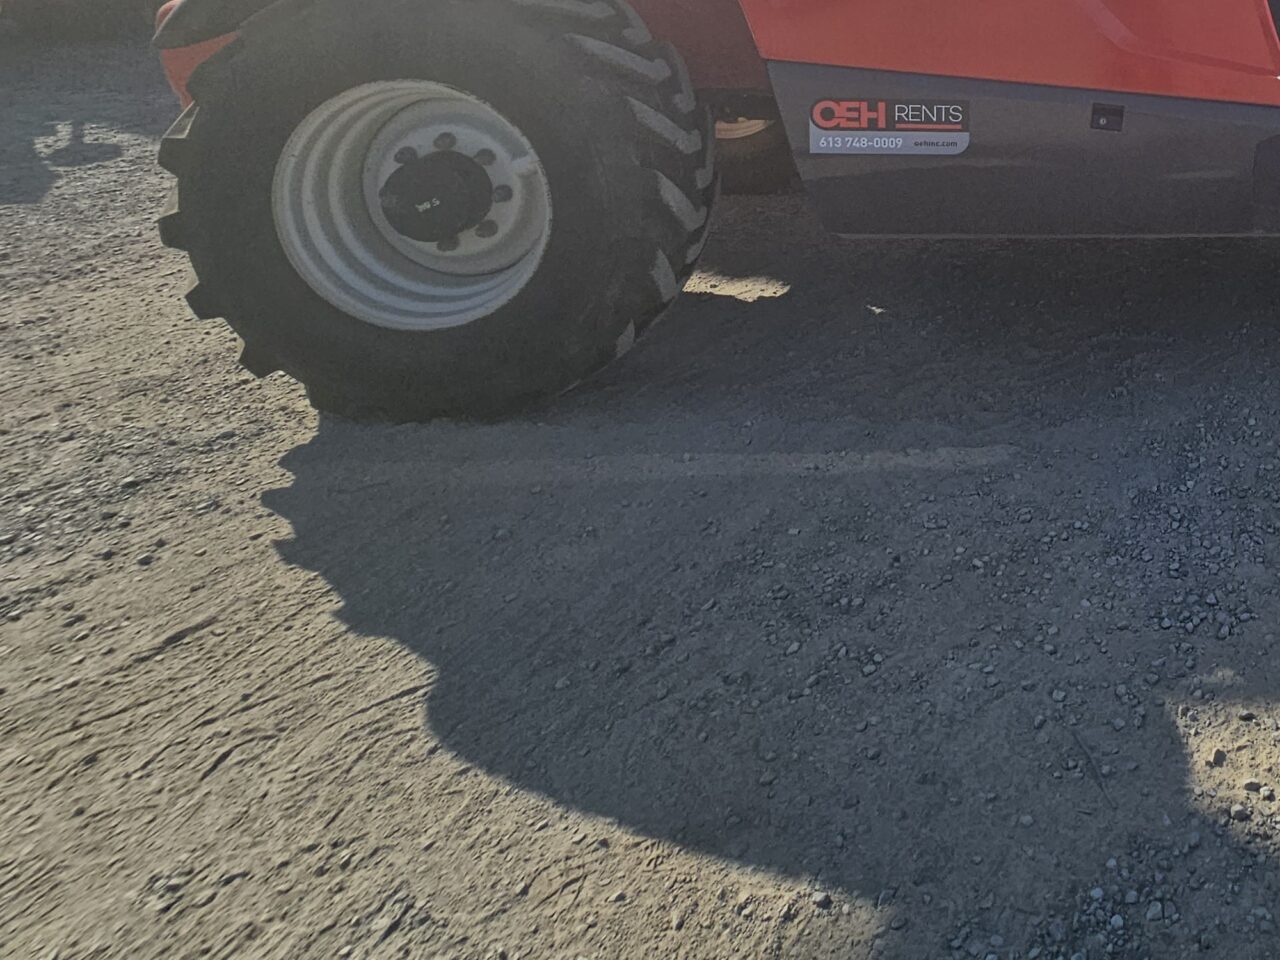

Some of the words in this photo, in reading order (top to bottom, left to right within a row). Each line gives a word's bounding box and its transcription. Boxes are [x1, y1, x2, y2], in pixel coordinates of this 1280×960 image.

[812, 100, 886, 128] OEH
[894, 104, 963, 122] RENTS
[819, 137, 841, 148] 613
[845, 137, 903, 149] 748-0009
